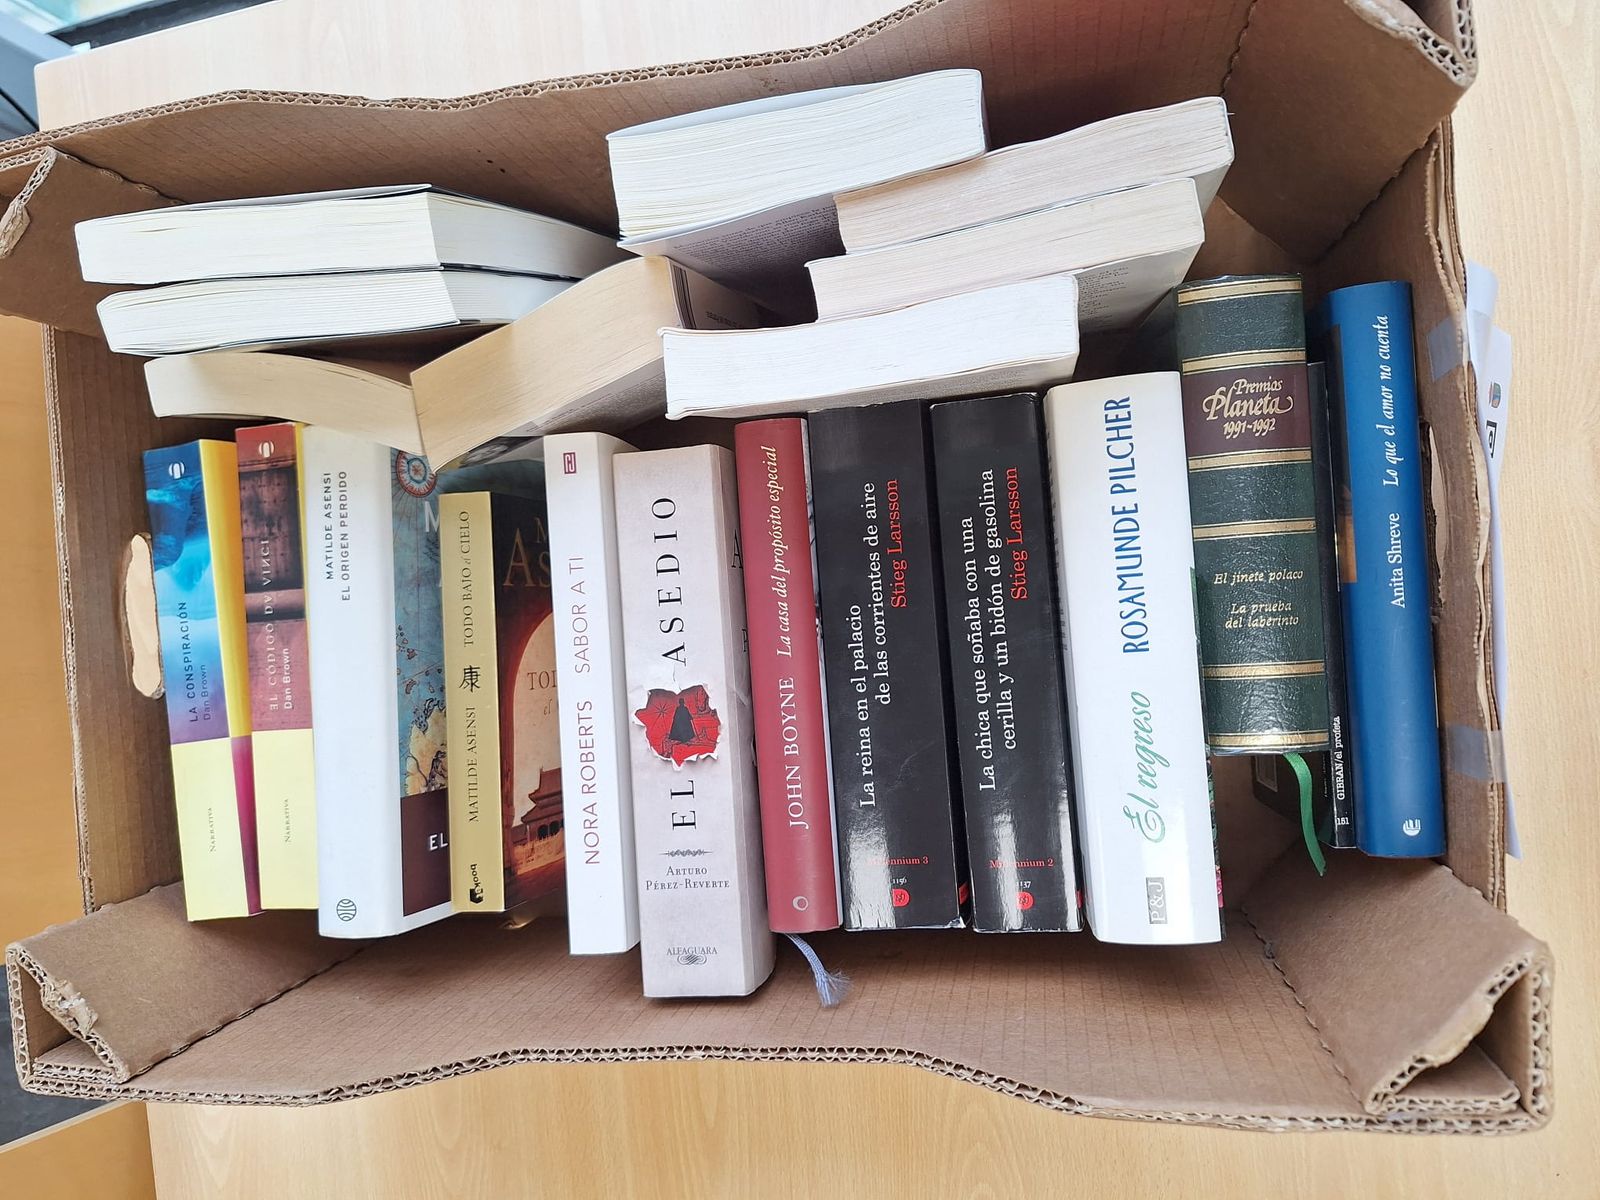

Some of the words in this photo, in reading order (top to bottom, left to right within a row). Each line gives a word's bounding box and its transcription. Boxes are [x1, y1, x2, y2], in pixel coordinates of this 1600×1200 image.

[1372, 314, 1390, 360] cuenta
[1233, 375, 1283, 395] Premios
[1380, 364, 1392, 380] no
[1202, 386, 1294, 420] Planeta
[1380, 386, 1394, 420] amor
[1103, 396, 1138, 495] PILCHER
[1376, 424, 1395, 436] el
[1384, 440, 1405, 465] que
[760, 445, 784, 503] especial
[1383, 468, 1399, 487] Lo
[323, 472, 333, 519] ASENSI
[338, 471, 348, 528] PERDIDO
[860, 481, 877, 520] aire
[979, 468, 1002, 549] gasolina
[1006, 467, 1025, 545] Larsson
[459, 510, 471, 554] CIELO
[862, 523, 880, 548] de
[886, 479, 904, 555] Larsson
[960, 516, 976, 554] una
[324, 524, 334, 580] MATILDE
[341, 533, 350, 581] ORIGEN
[767, 504, 791, 575] propósito
[1387, 512, 1404, 565] Shreve
[461, 566, 473, 602] BAJO
[568, 557, 585, 575] TI
[651, 497, 688, 667] ASEDIO
[890, 559, 908, 609] Stieg
[965, 558, 977, 592] con
[984, 553, 1001, 577] de
[1010, 549, 1029, 600] Stieg
[1111, 503, 1150, 654] ROSAMUNDE
[1214, 572, 1228, 585] El
[1230, 571, 1265, 586] jinete
[1268, 569, 1304, 584] polaco
[341, 586, 351, 601] EL
[570, 580, 586, 595] A
[771, 575, 788, 598] del
[867, 550, 887, 645] corrientes
[1390, 567, 1406, 609] Anita
[462, 605, 474, 648] TODO
[777, 600, 790, 631] casa
[987, 581, 1007, 638] bidón
[1225, 617, 1243, 629] del
[1247, 615, 1299, 628] laberinto
[1231, 603, 1248, 614] La
[1251, 601, 1292, 615] prueba
[571, 603, 591, 674] SABOR
[777, 633, 793, 658] La
[846, 604, 868, 671] palacio
[964, 596, 985, 665] soñaba
[178, 602, 197, 699] CONSPIRACIÓN
[265, 622, 278, 686] CÓDIGO
[281, 648, 293, 685] Brown
[873, 648, 889, 679] las
[996, 640, 1009, 667] un
[200, 664, 210, 698] Brown
[459, 664, 481, 693] 康
[850, 676, 867, 693] el
[875, 681, 891, 705] de
[974, 668, 992, 704] que
[1000, 670, 1015, 685] y
[190, 706, 199, 723] LA
[203, 700, 211, 721] Dan
[282, 687, 294, 710] Dan
[778, 677, 800, 757] BOYNE
[856, 698, 869, 721] en
[466, 706, 479, 755] ASENSI
[974, 709, 993, 760] chica
[997, 688, 1018, 750] cerilla
[1332, 716, 1344, 749] profeta
[576, 700, 598, 796] ROBERTS
[856, 726, 874, 777] reina
[1130, 691, 1171, 790] regreso
[467, 757, 480, 824] MATILDE
[784, 765, 809, 830] JOHN
[859, 781, 876, 808] La
[979, 766, 997, 791] La
[669, 779, 697, 830] EL
[1122, 792, 1166, 844] El
[429, 834, 449, 851] EL
[582, 801, 601, 865] NORA
[922, 855, 929, 865] 3
[1048, 858, 1054, 867] 2
[1149, 881, 1165, 921] P&J
[666, 946, 718, 956] ALFAGUARA
